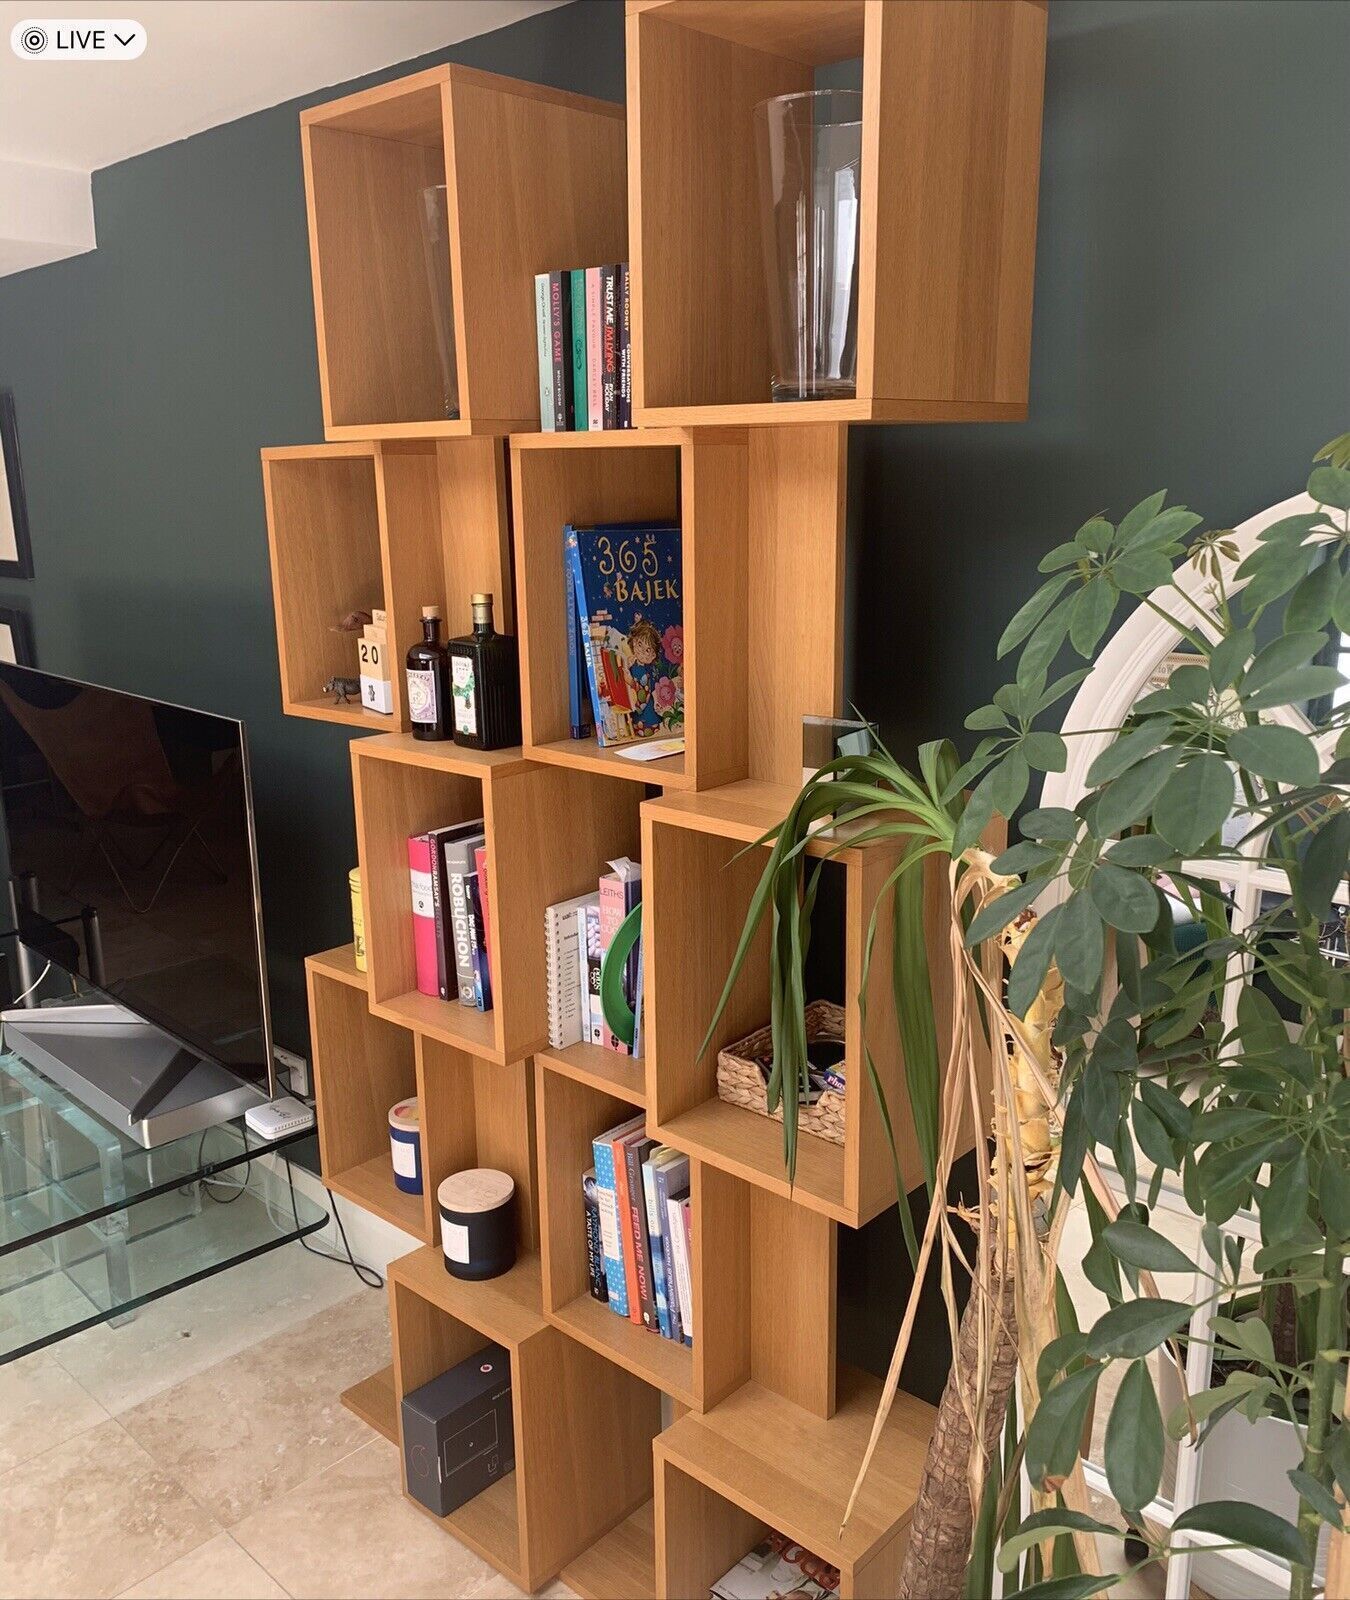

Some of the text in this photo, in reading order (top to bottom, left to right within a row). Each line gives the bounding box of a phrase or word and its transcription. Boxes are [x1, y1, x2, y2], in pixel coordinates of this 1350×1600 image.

[552, 282, 561, 363] MOLLY'S GAME
[605, 341, 613, 373] LYING
[598, 535, 658, 576] 365
[615, 577, 679, 606] BAJEK
[580, 616, 592, 668] 365 BAJEK
[600, 888, 624, 899] LEITHS
[450, 873, 470, 967] ROBUCHON
[587, 1239, 593, 1250] OF
[589, 1251, 594, 1263] MY
[591, 1205, 602, 1287] RAYMOND BLANC
[631, 1206, 648, 1301] FEED ME NOW!
